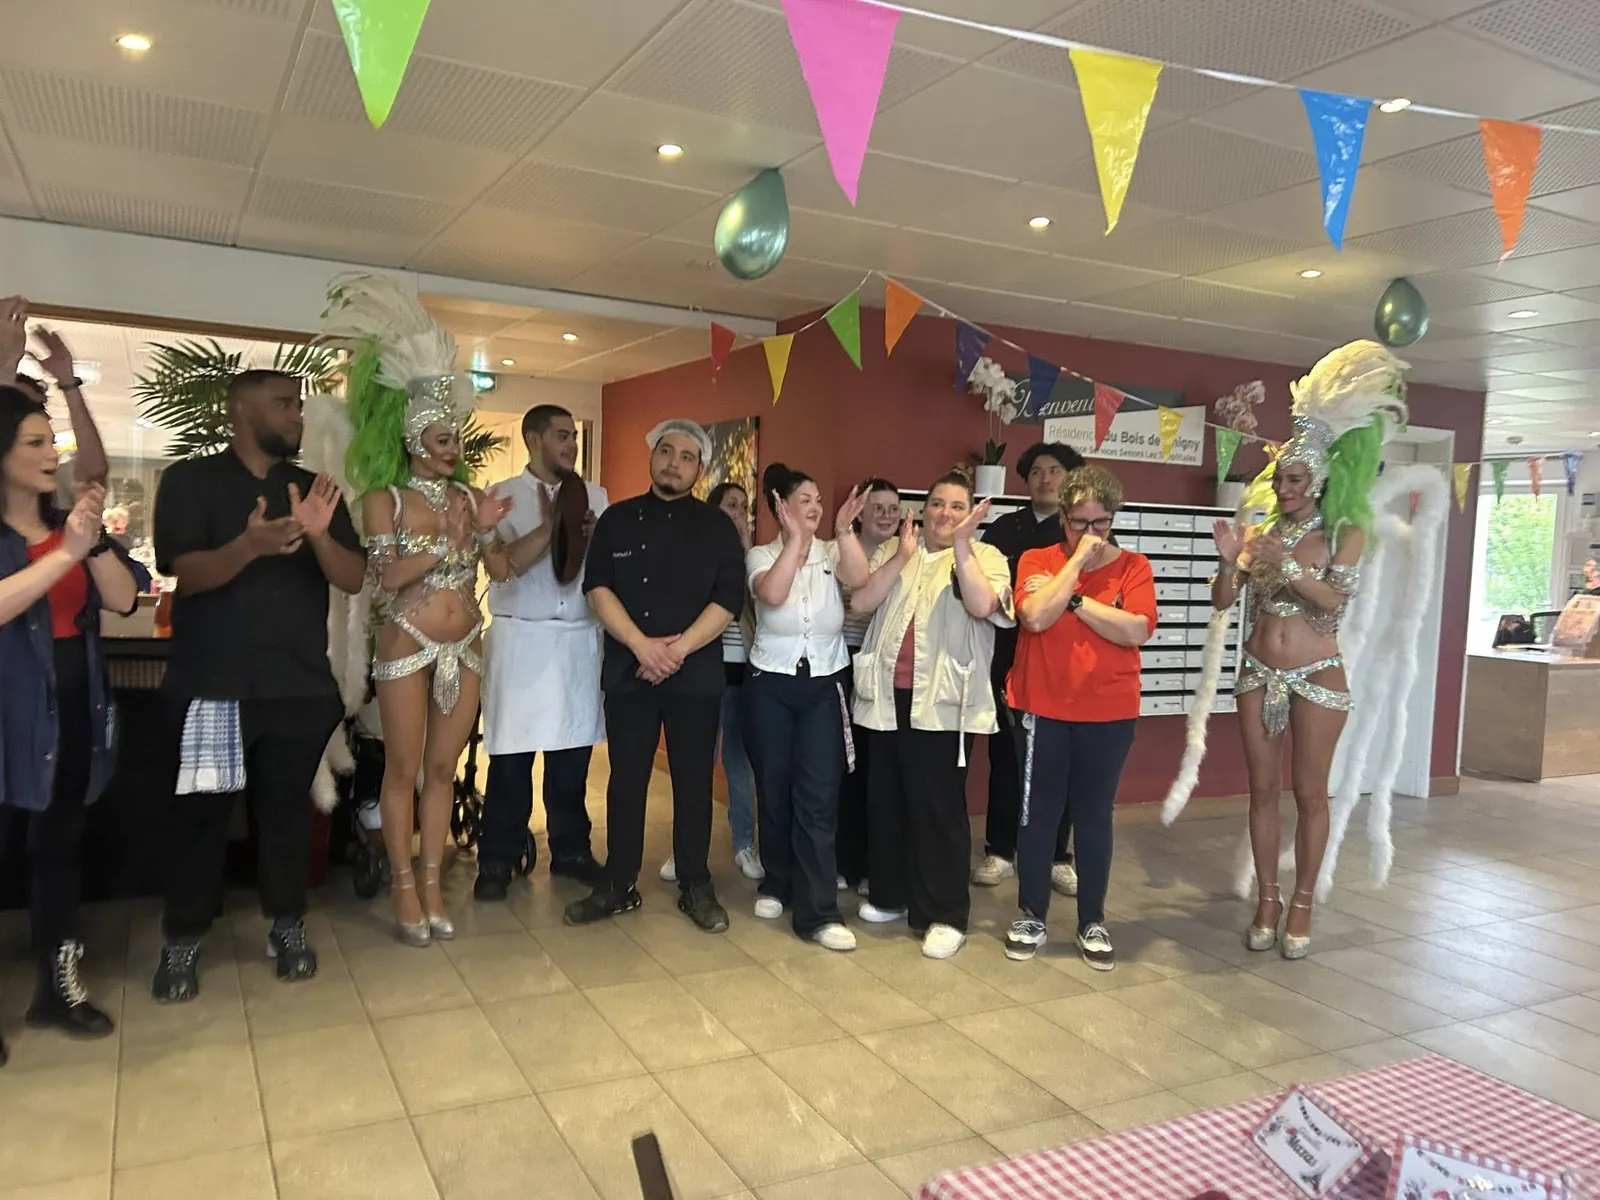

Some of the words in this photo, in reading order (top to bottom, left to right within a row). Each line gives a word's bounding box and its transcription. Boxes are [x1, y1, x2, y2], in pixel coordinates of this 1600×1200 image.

[1048, 424, 1095, 441] Résidenc
[1121, 431, 1145, 446] Bois
[1148, 433, 1161, 446] de
[1091, 446, 1118, 456] Sevices
